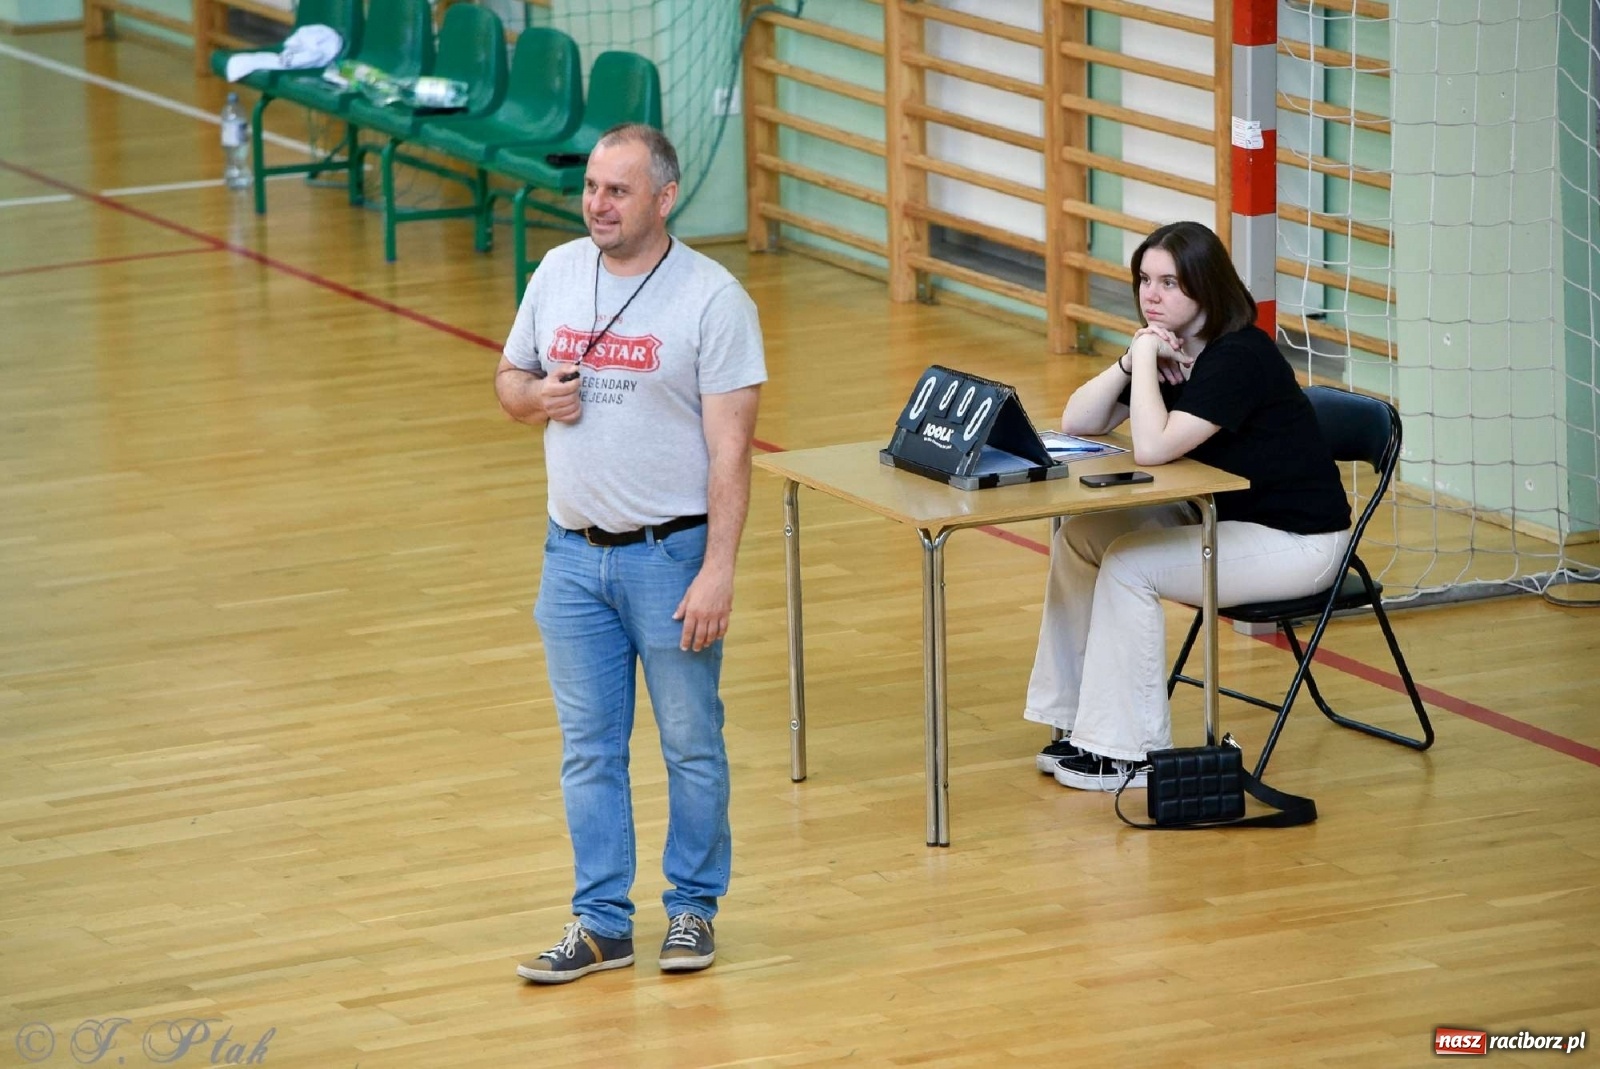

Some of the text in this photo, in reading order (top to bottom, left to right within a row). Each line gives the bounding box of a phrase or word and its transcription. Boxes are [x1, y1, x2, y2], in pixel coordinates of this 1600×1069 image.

[556, 337, 646, 362] BIG STAR
[581, 376, 638, 392] EGENDARY
[588, 393, 624, 405] JEANS
[909, 376, 993, 441] 0 0 0 0
